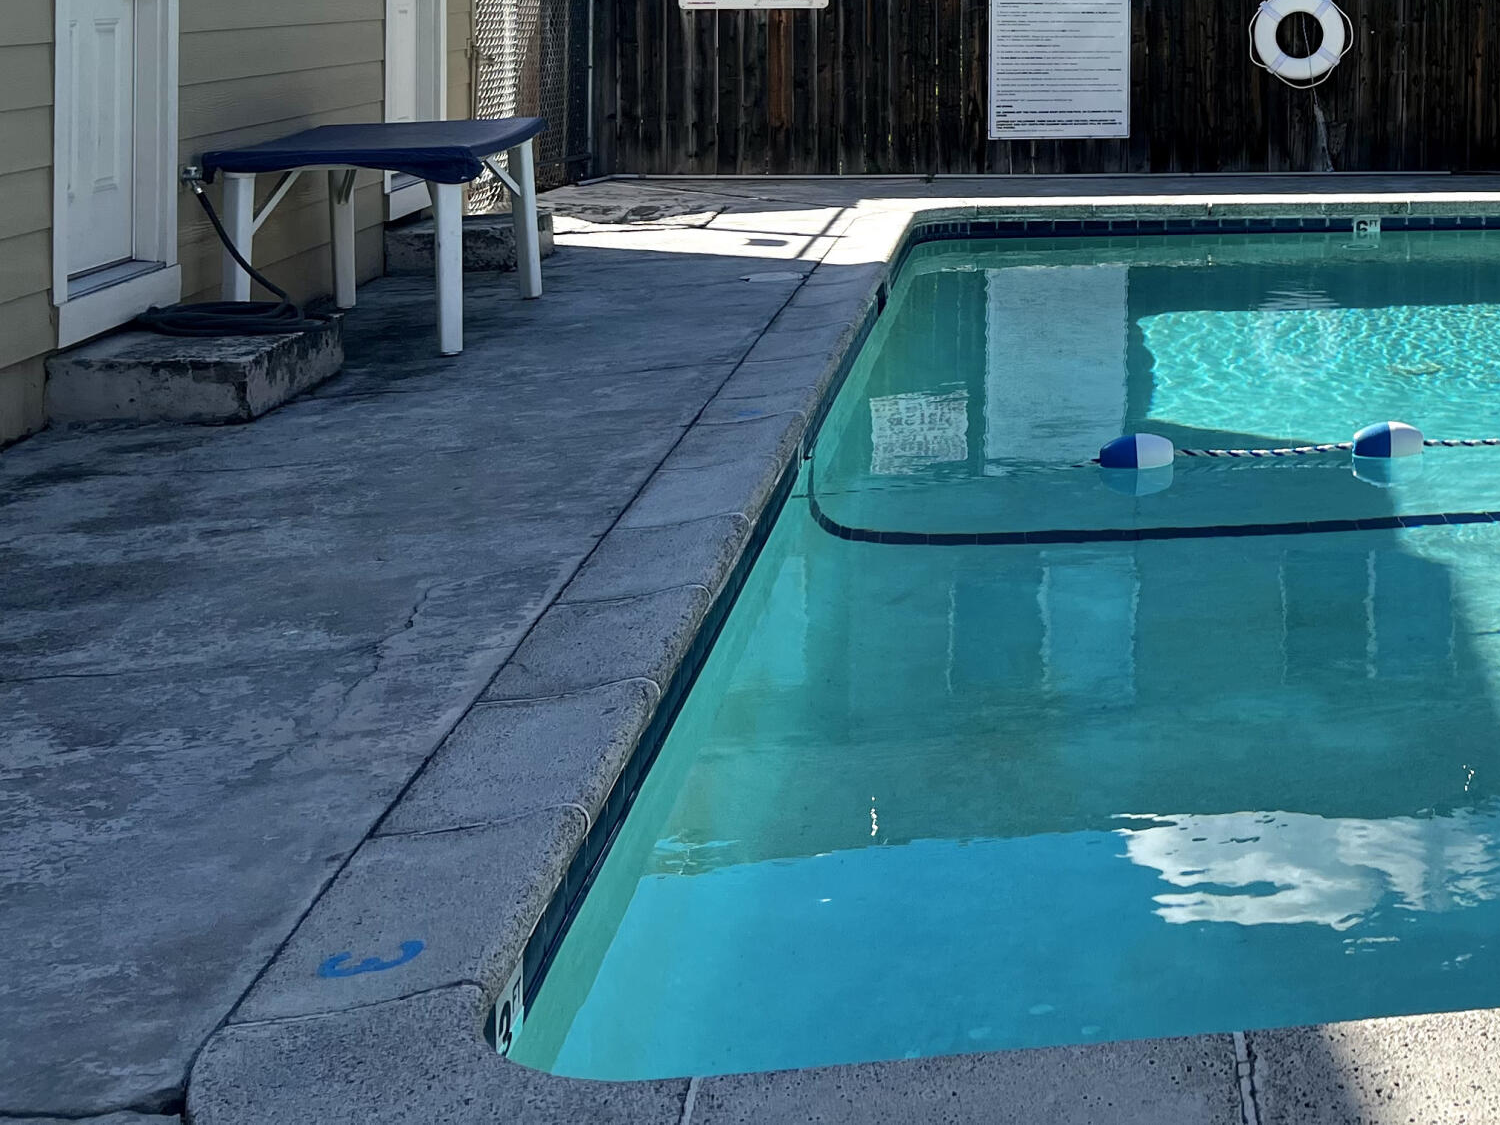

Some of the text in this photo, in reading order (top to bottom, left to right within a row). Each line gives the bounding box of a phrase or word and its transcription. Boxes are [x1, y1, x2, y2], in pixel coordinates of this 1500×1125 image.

[1356, 220, 1368, 232] 6
[316, 940, 425, 978] 3
[512, 976, 521, 1013] FT
